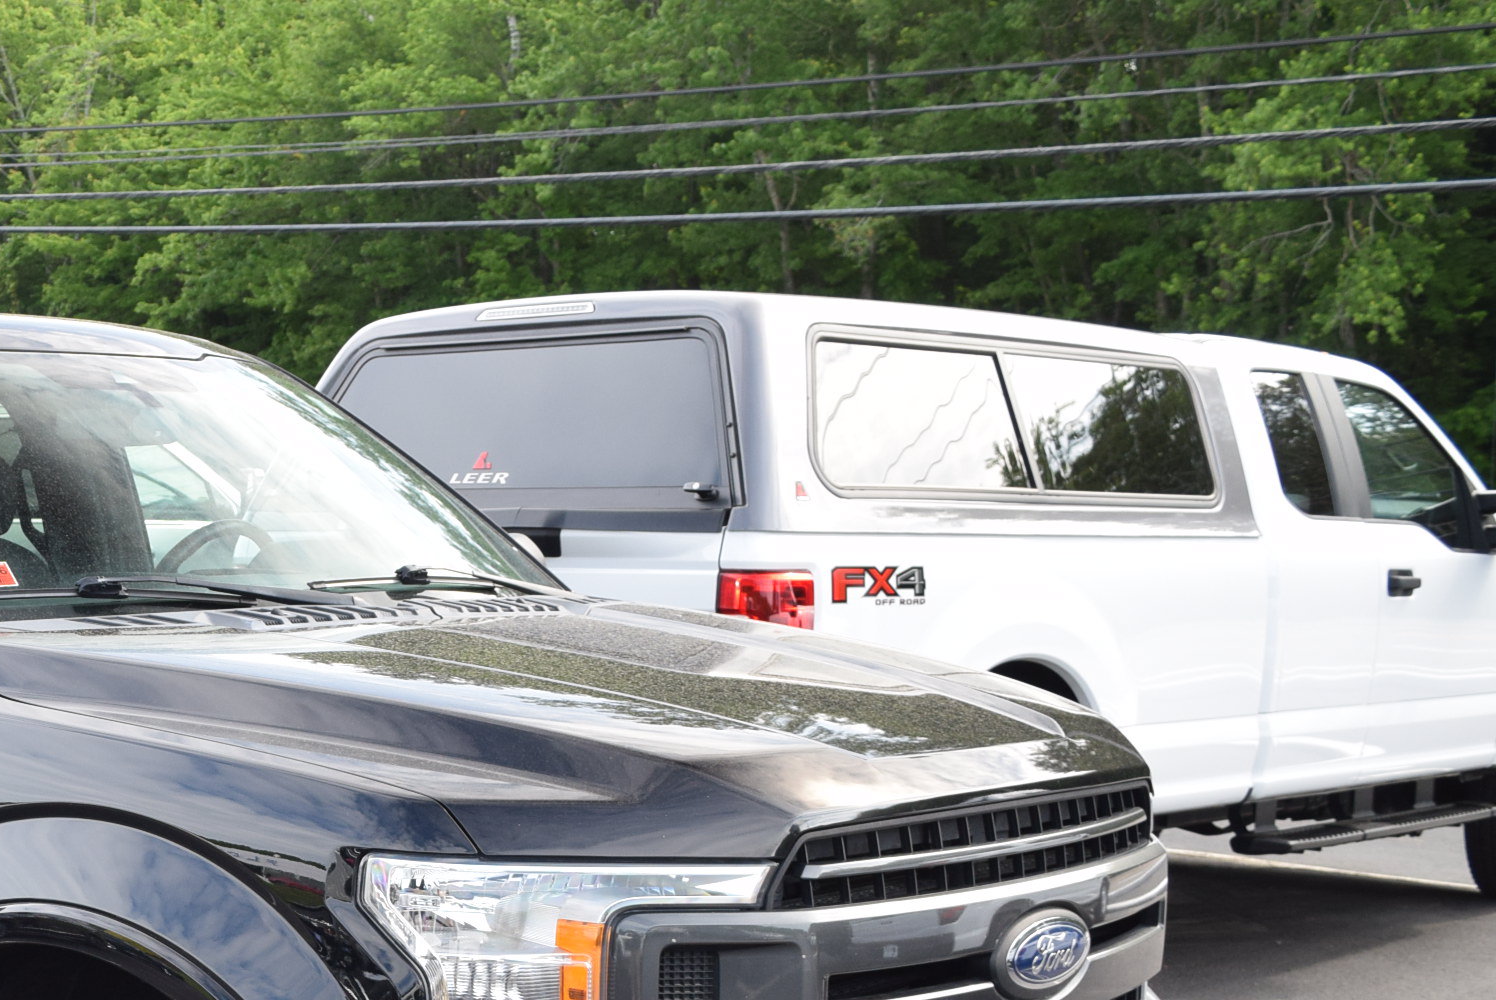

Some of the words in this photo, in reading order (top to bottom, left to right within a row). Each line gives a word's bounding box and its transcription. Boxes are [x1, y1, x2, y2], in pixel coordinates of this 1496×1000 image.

[449, 472, 510, 485] LEER
[831, 566, 927, 604] FX4
[875, 598, 896, 606] OFF
[899, 597, 927, 606] ROAD
[1031, 931, 1077, 976] Ford
